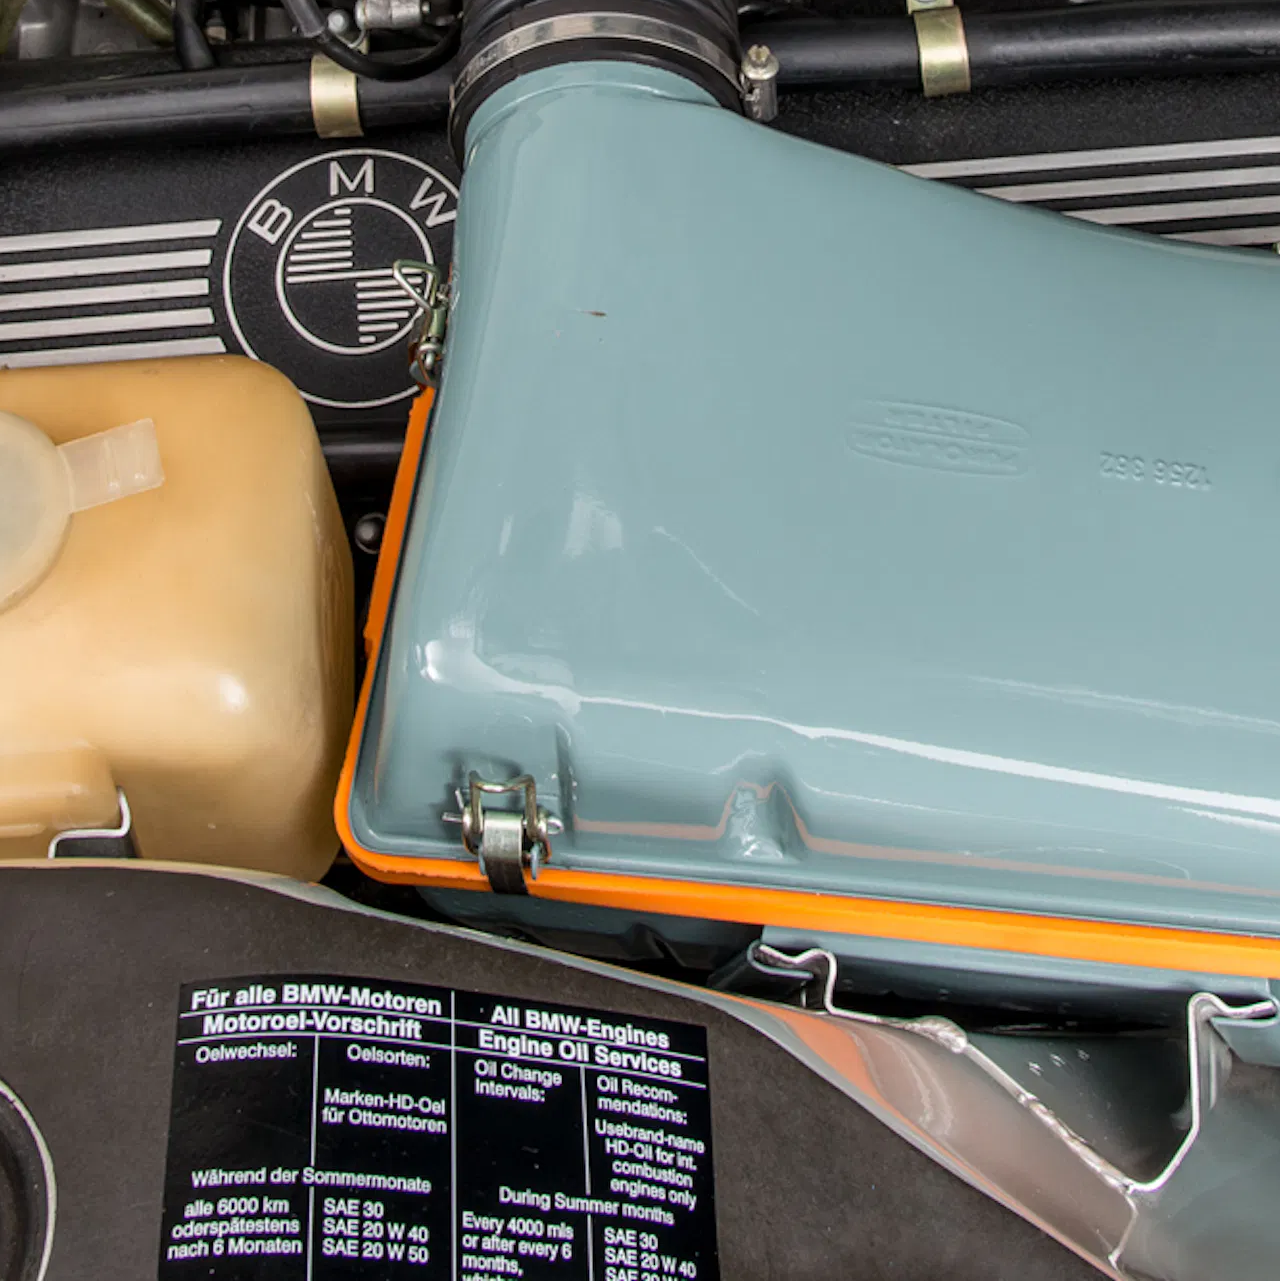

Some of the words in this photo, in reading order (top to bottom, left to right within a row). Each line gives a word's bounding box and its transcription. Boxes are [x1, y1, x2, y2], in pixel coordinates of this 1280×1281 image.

[247, 158, 457, 245] BMW
[191, 989, 230, 1011] Für
[235, 985, 276, 1006] alle
[282, 984, 441, 1016] BMW-Motoren
[202, 1010, 422, 1039] Motoroel-Vorschrift
[491, 1005, 519, 1027] All
[525, 1009, 670, 1049] BMW-Engines
[195, 1042, 297, 1063] Oelwechsel:
[347, 1044, 430, 1069] Oelsorten:
[479, 1028, 553, 1058] Engine
[559, 1040, 588, 1063] Oil
[595, 1045, 681, 1078] Services
[474, 1060, 496, 1077] Oil
[501, 1063, 562, 1087] Change
[324, 1088, 446, 1116] Marken-HD-Oel
[475, 1079, 545, 1103] Intervals:
[597, 1075, 618, 1093] Oil
[622, 1078, 678, 1104] Recom-
[322, 1105, 345, 1124] für
[349, 1109, 447, 1134] Ottomotoren
[598, 1097, 687, 1125] mendations:
[605, 1138, 653, 1161] HD-Oil
[655, 1146, 675, 1164] for
[677, 1151, 697, 1171] int.
[192, 1168, 266, 1188] Während
[270, 1168, 299, 1184] der
[302, 1167, 432, 1194] Sommermonate
[612, 1160, 693, 1188] combustion
[184, 1199, 214, 1218] alle
[217, 1198, 259, 1215] 6000
[263, 1196, 289, 1214] km
[323, 1198, 360, 1217] SAE
[362, 1201, 384, 1218] 30
[499, 1186, 551, 1211] During
[555, 1192, 620, 1216] Summer
[622, 1202, 674, 1226] months
[610, 1178, 666, 1202] engines
[668, 1190, 697, 1212] only
[322, 1217, 359, 1237] SAE
[362, 1221, 383, 1239] 20
[387, 1223, 406, 1241] W
[407, 1226, 429, 1243] 40
[462, 1211, 504, 1235] Every
[507, 1218, 544, 1237] 4000
[167, 1240, 209, 1260] nach
[212, 1239, 224, 1256] 6
[228, 1237, 303, 1255] Monaten
[322, 1237, 359, 1257] SAE
[362, 1241, 383, 1259] 20
[387, 1243, 405, 1262] W
[407, 1246, 429, 1264] 50
[462, 1236, 479, 1250] or
[481, 1234, 516, 1254] after
[518, 1240, 558, 1261] every
[562, 1243, 572, 1260] 6
[604, 1226, 637, 1247] SAE
[639, 1234, 659, 1252] 30
[462, 1253, 524, 1278] months,
[605, 1246, 638, 1267] SAE
[640, 1252, 660, 1271] 20
[661, 1255, 677, 1274] W
[679, 1261, 697, 1278] 40
